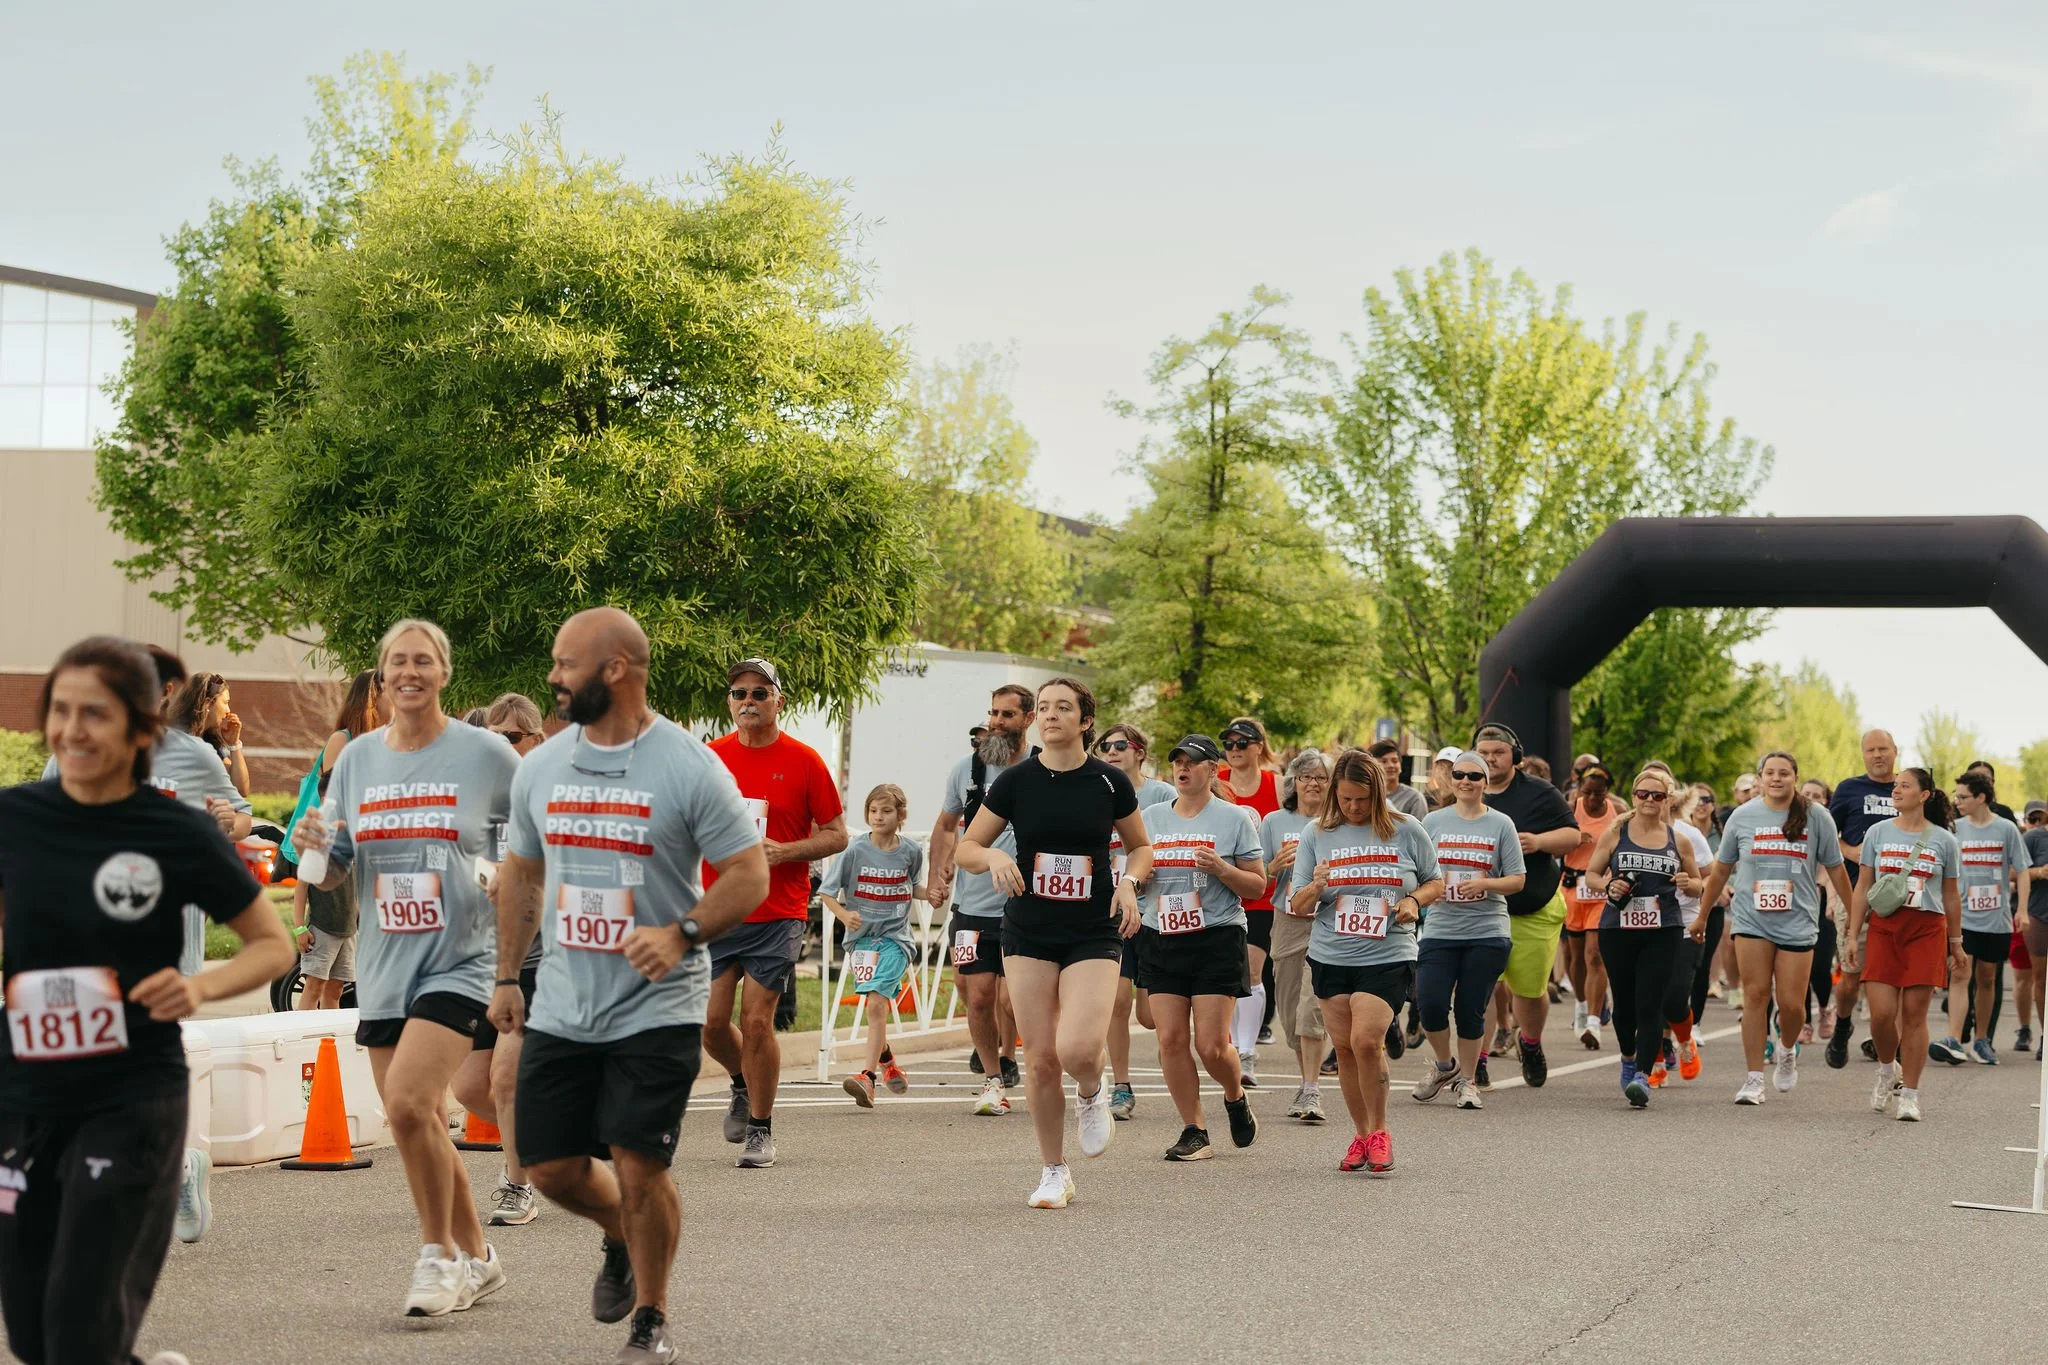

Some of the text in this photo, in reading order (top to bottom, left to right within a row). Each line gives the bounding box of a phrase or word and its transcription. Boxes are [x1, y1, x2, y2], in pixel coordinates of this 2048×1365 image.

[365, 782, 459, 803] PREVENT
[552, 784, 654, 806] PREVENT
[358, 812, 455, 831] PROTECT
[546, 817, 649, 844] PROTECT
[1155, 833, 1217, 844] PREVENT
[1440, 833, 1497, 845] PREVENT
[1961, 840, 2004, 849] PREVENT
[1331, 845, 1399, 860] PREVENT
[1753, 841, 1807, 853] PROTECT
[1882, 843, 1937, 856] PREVNT
[1054, 857, 1072, 865] RUN
[1437, 850, 1493, 864] PROTECT
[1618, 854, 1680, 874] LIBERTY
[1961, 853, 2003, 862] PROTECT
[1329, 866, 1399, 880] PROTECT
[1037, 874, 1085, 897] 1841
[1355, 897, 1370, 905] RUN
[1760, 894, 1787, 908] 536
[1971, 896, 1997, 909] 1821
[380, 900, 438, 927] 1905
[1160, 909, 1201, 931] 1845
[1623, 911, 1658, 926] 1882
[562, 914, 628, 945] 1907
[1338, 913, 1384, 935] 1847
[16, 1007, 118, 1051] 1812
